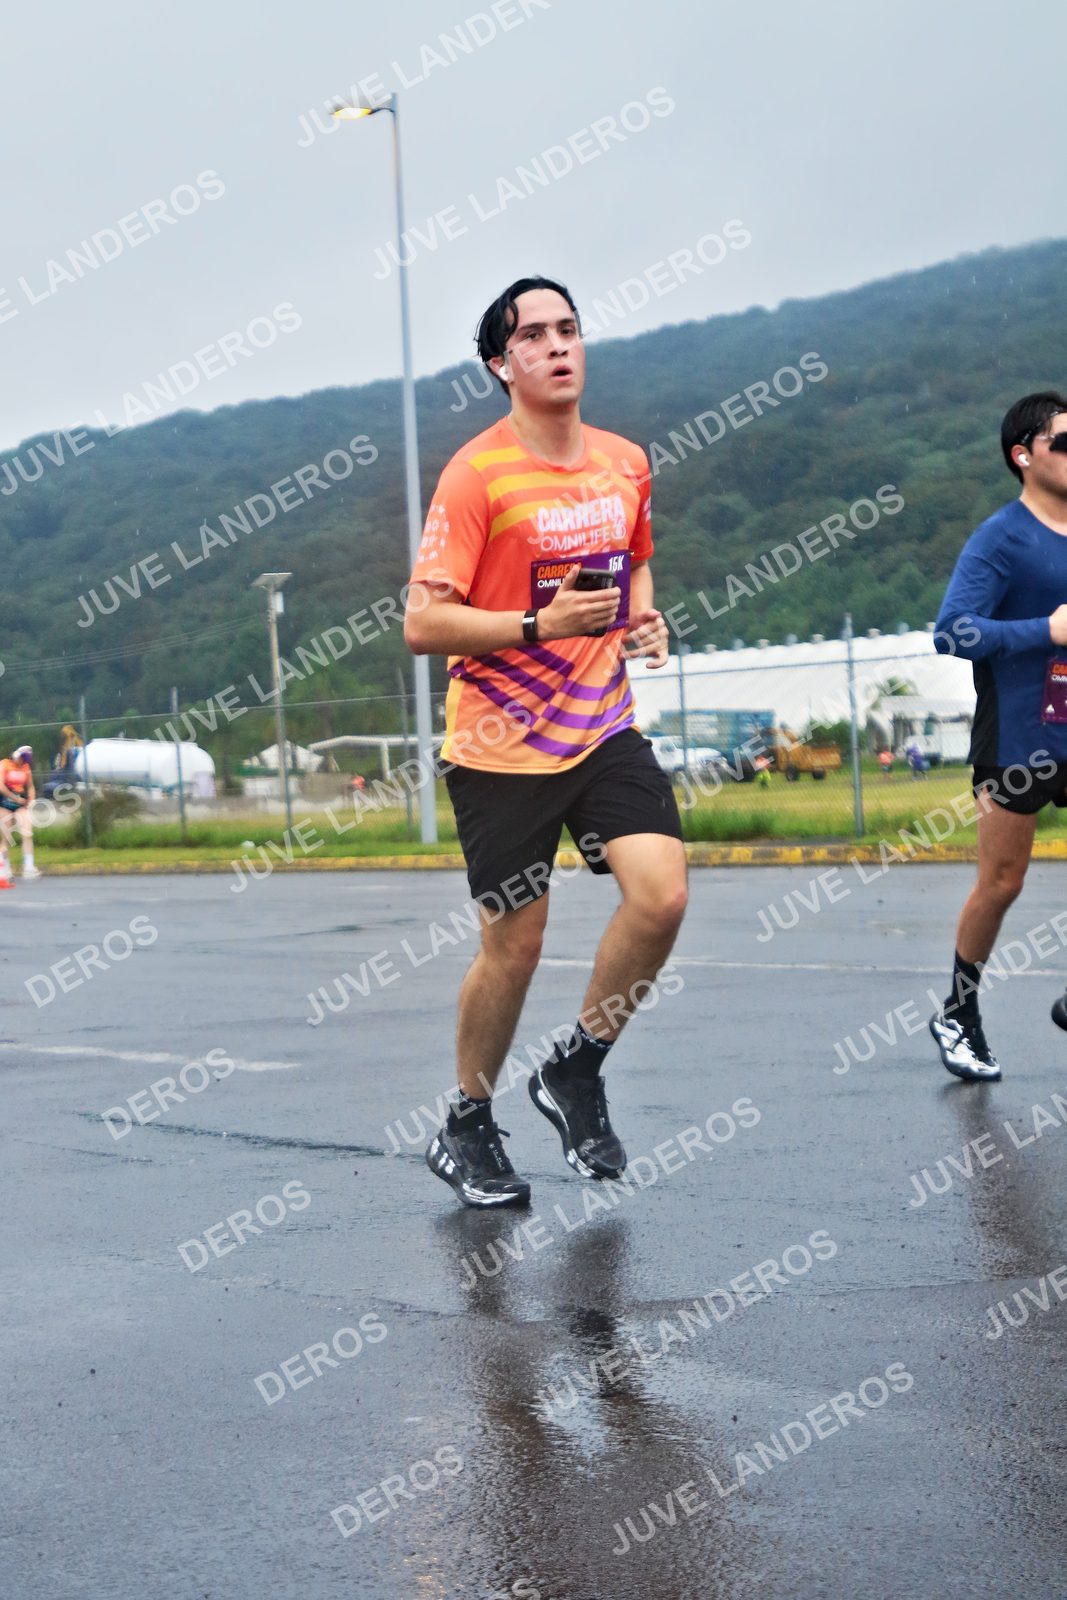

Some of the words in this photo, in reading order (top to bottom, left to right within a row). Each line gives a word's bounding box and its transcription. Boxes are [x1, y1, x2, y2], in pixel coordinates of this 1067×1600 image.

[538, 496, 625, 532] CARRERA
[540, 525, 611, 551] OMNILIFE
[537, 562, 582, 579] CARRE
[608, 555, 624, 572] 15K
